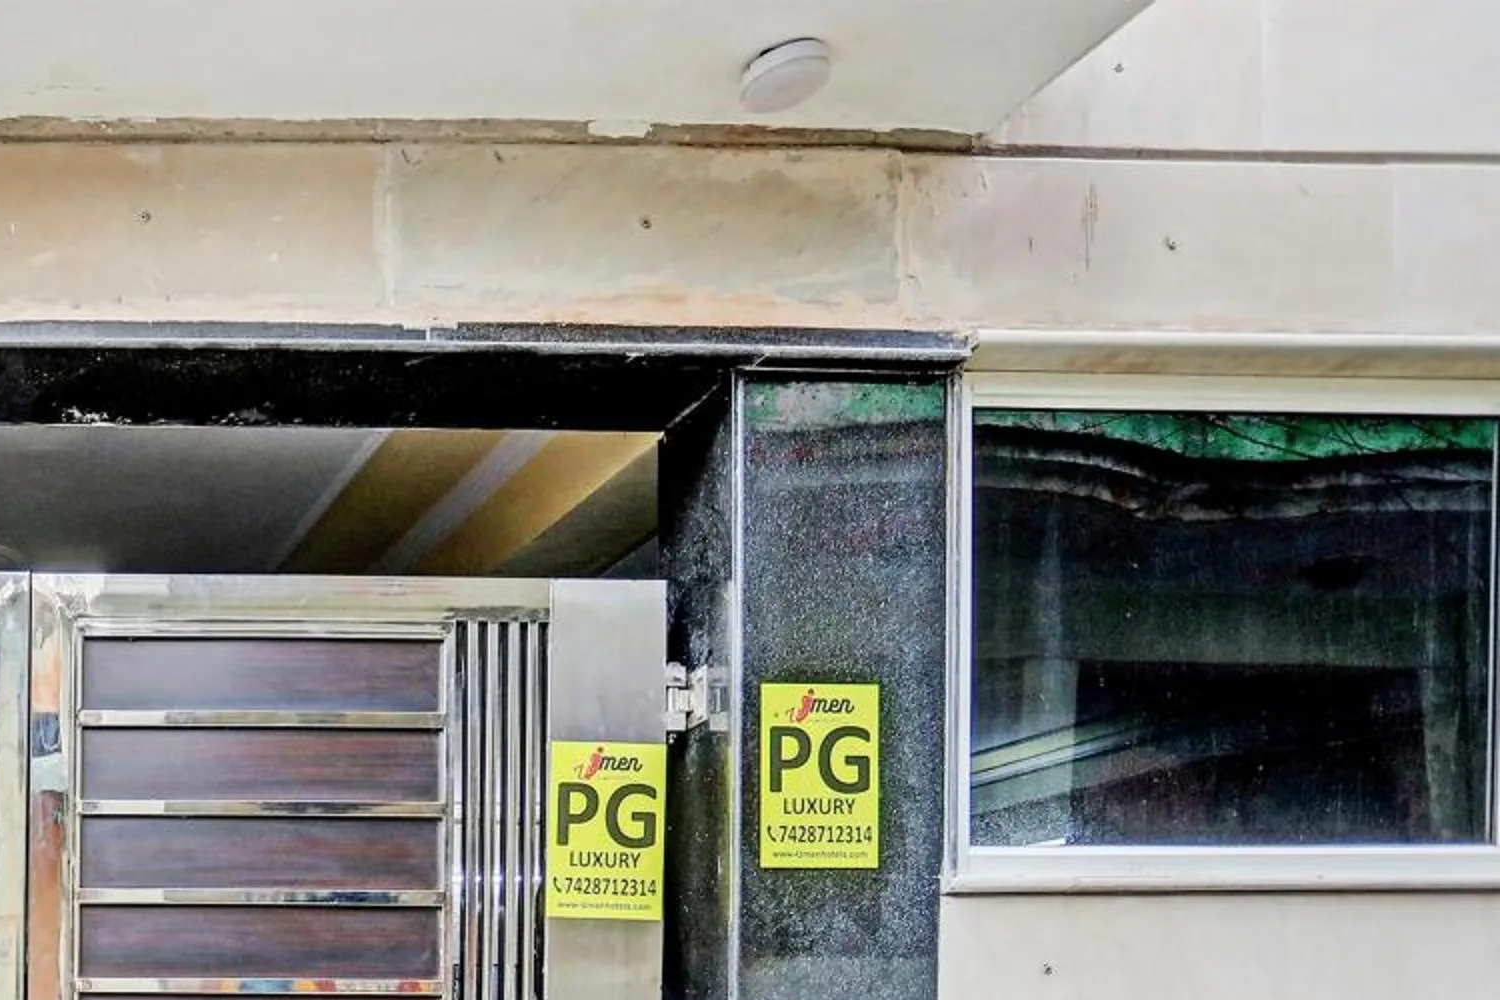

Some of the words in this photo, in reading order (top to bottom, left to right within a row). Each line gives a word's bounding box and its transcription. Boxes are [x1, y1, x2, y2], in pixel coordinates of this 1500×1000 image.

[769, 726, 871, 794] PG
[556, 781, 658, 849] PG
[783, 798, 856, 815] LUXURY
[779, 825, 872, 843] 7428712314
[569, 851, 641, 868] LUXURY
[564, 877, 657, 896] 7428712314
